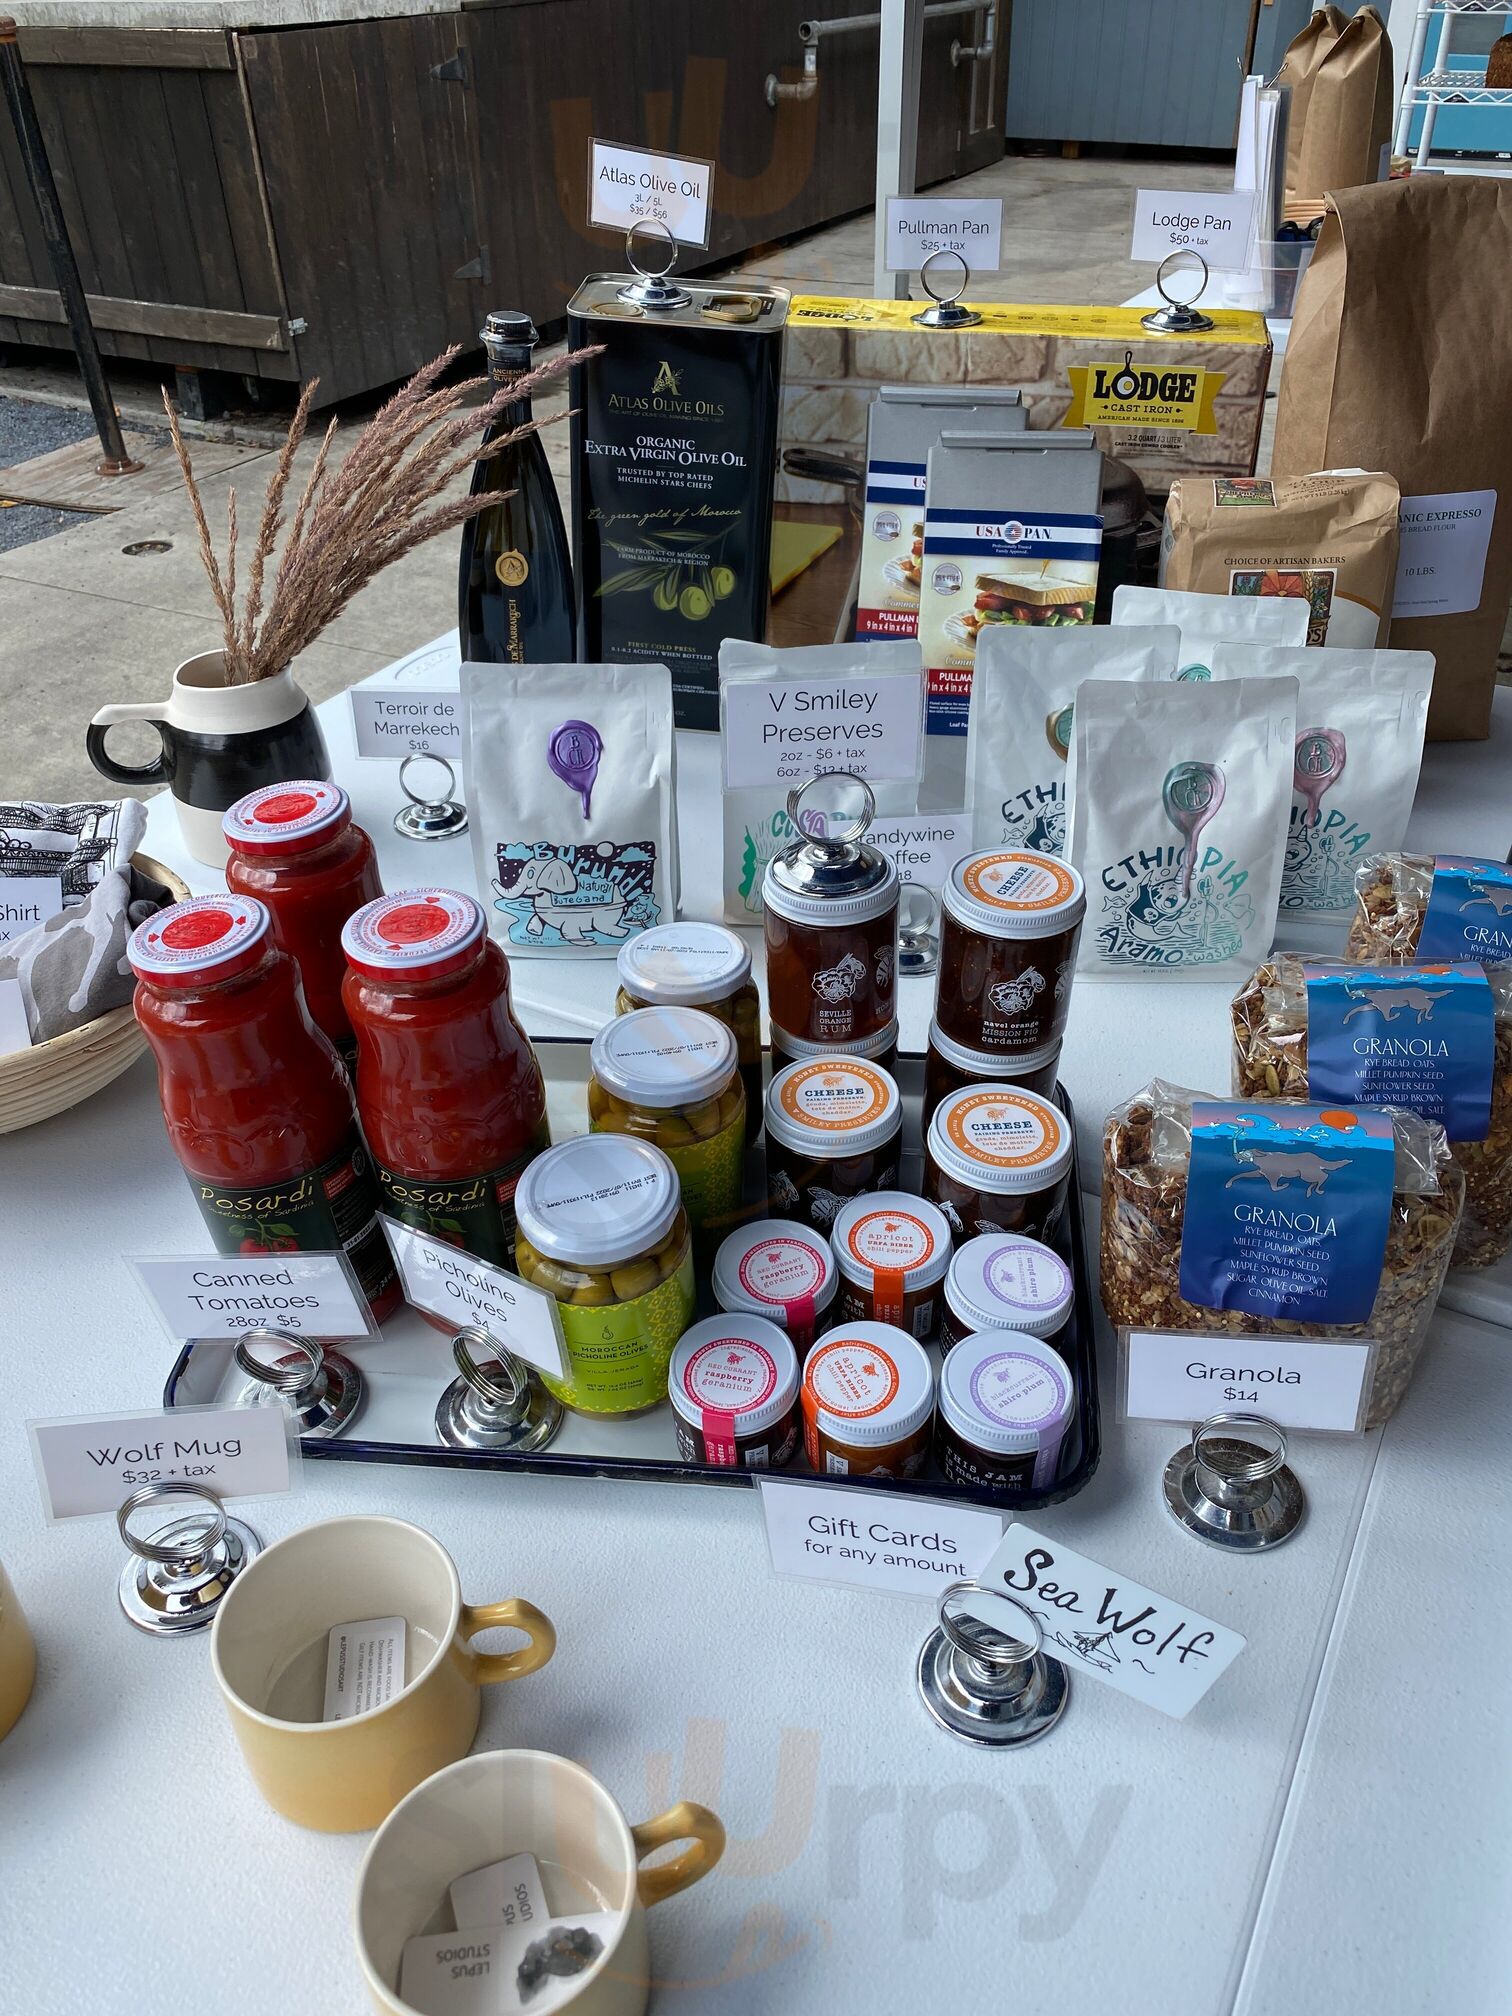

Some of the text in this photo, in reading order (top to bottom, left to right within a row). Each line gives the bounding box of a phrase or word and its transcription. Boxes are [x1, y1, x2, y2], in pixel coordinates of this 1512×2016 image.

[600, 166, 700, 198] Atlas Olive Oil
[635, 194, 662, 207] 3L 5L
[630, 204, 668, 219] $35 $56
[898, 220, 990, 234] Pullman Pan
[1152, 211, 1232, 232] Lodge Pan
[921, 240, 965, 252] $25 tax
[1169, 232, 1209, 245] $50 tax
[1093, 363, 1197, 403] LODGE
[608, 394, 725, 416] ATLAS OLIVE OILS
[1111, 403, 1173, 414] CAST IRON
[636, 436, 696, 450] ORGANIC
[584, 439, 747, 467] EXTRA VIRGIN OLIVE OIL
[616, 467, 654, 476] TRUSTED
[669, 471, 685, 479] TOP
[687, 473, 714, 482] RATED
[617, 475, 713, 490] MICHELIN STARS CHEFS
[1426, 508, 1482, 522] EXPRESSO
[976, 526, 1052, 540] USA PAN
[1408, 525, 1433, 533] BREAD
[1433, 523, 1457, 532] FLOUR
[677, 551, 711, 560] MOROCCO
[1224, 556, 1346, 566] CHOICE OF ARTISAN BAKERS
[1405, 568, 1415, 577] 10
[879, 612, 915, 623] PULLMAN
[682, 652, 713, 660] BOTTLED
[375, 701, 454, 716] Terroir de
[769, 689, 879, 714] V Smiley
[374, 720, 461, 737] Marrekech
[763, 722, 883, 744] Preserves
[408, 739, 430, 751] $16
[780, 748, 866, 762] 2oz $6 tax
[776, 764, 867, 778] 6oz tax
[859, 826, 955, 848] randywine
[532, 841, 652, 901] Burundi
[578, 880, 613, 893] Natural
[996, 866, 1029, 896] CHEESE
[1470, 943, 1484, 954] RYE
[819, 1009, 852, 1018] SEVILLE
[819, 1024, 852, 1033] RUM
[981, 1027, 1023, 1037] MISSION
[983, 1020, 1039, 1029] navel orange
[981, 1034, 1038, 1045] cardamom
[1353, 1037, 1449, 1057] GRANOLA
[1364, 1058, 1380, 1067] RYE
[793, 1064, 874, 1083] HONEY SWEETENED
[1383, 1070, 1421, 1079] PUMPKIN
[805, 1087, 865, 1097] CHEESE
[1362, 1082, 1412, 1091] SUNFLOWER
[956, 1094, 1039, 1115] HONEY SWEETENED
[1354, 1093, 1443, 1103] MAPLE BROWN
[971, 1120, 1033, 1131] CHEESE
[201, 1176, 313, 1211] Posardi
[379, 1169, 487, 1205] Posardi
[207, 1204, 254, 1220] Sweetness
[257, 1211, 270, 1220] of
[1234, 1204, 1337, 1237] GRANOLA
[868, 1233, 913, 1242] apricot
[1244, 1225, 1262, 1236] RYE
[1264, 1241, 1305, 1256] PUMPKIN
[1240, 1249, 1294, 1267] SUNFLOWER
[760, 1263, 804, 1281] raspberry
[1027, 1257, 1037, 1276] plum
[1230, 1259, 1328, 1286] MAPLE BROWN
[192, 1270, 294, 1288] Canned
[423, 1249, 516, 1305] Picholine
[763, 1269, 809, 1289] geranium
[1260, 1277, 1287, 1291] OLIVE
[188, 1294, 320, 1311] Tomatoes
[445, 1280, 508, 1322] Olives
[226, 1314, 302, 1328] 28oz $5
[471, 1311, 490, 1331] $4
[573, 1344, 649, 1360] PICHOLINE OLIVES
[581, 1341, 638, 1353] MOROCCAN
[707, 1362, 758, 1376] RED CURRANT
[842, 1356, 872, 1396] apricot
[1186, 1362, 1301, 1385] Granola
[705, 1370, 754, 1384] raspberry
[701, 1378, 752, 1393] geranium
[836, 1381, 854, 1403] pepper
[998, 1379, 1045, 1409] shiro plum
[1223, 1386, 1259, 1403] $14
[86, 1439, 241, 1466] Wolf Mug
[122, 1464, 216, 1484] $32 tax
[955, 1465, 988, 1487] made
[984, 1471, 1023, 1482] JAM
[807, 1515, 958, 1554] Gift Cards
[804, 1539, 967, 1578] for any amount
[1003, 1548, 1215, 1665] Sea Wolf
[436, 1944, 490, 1965] STUDIOS
[451, 1961, 490, 1980] LEPUS
